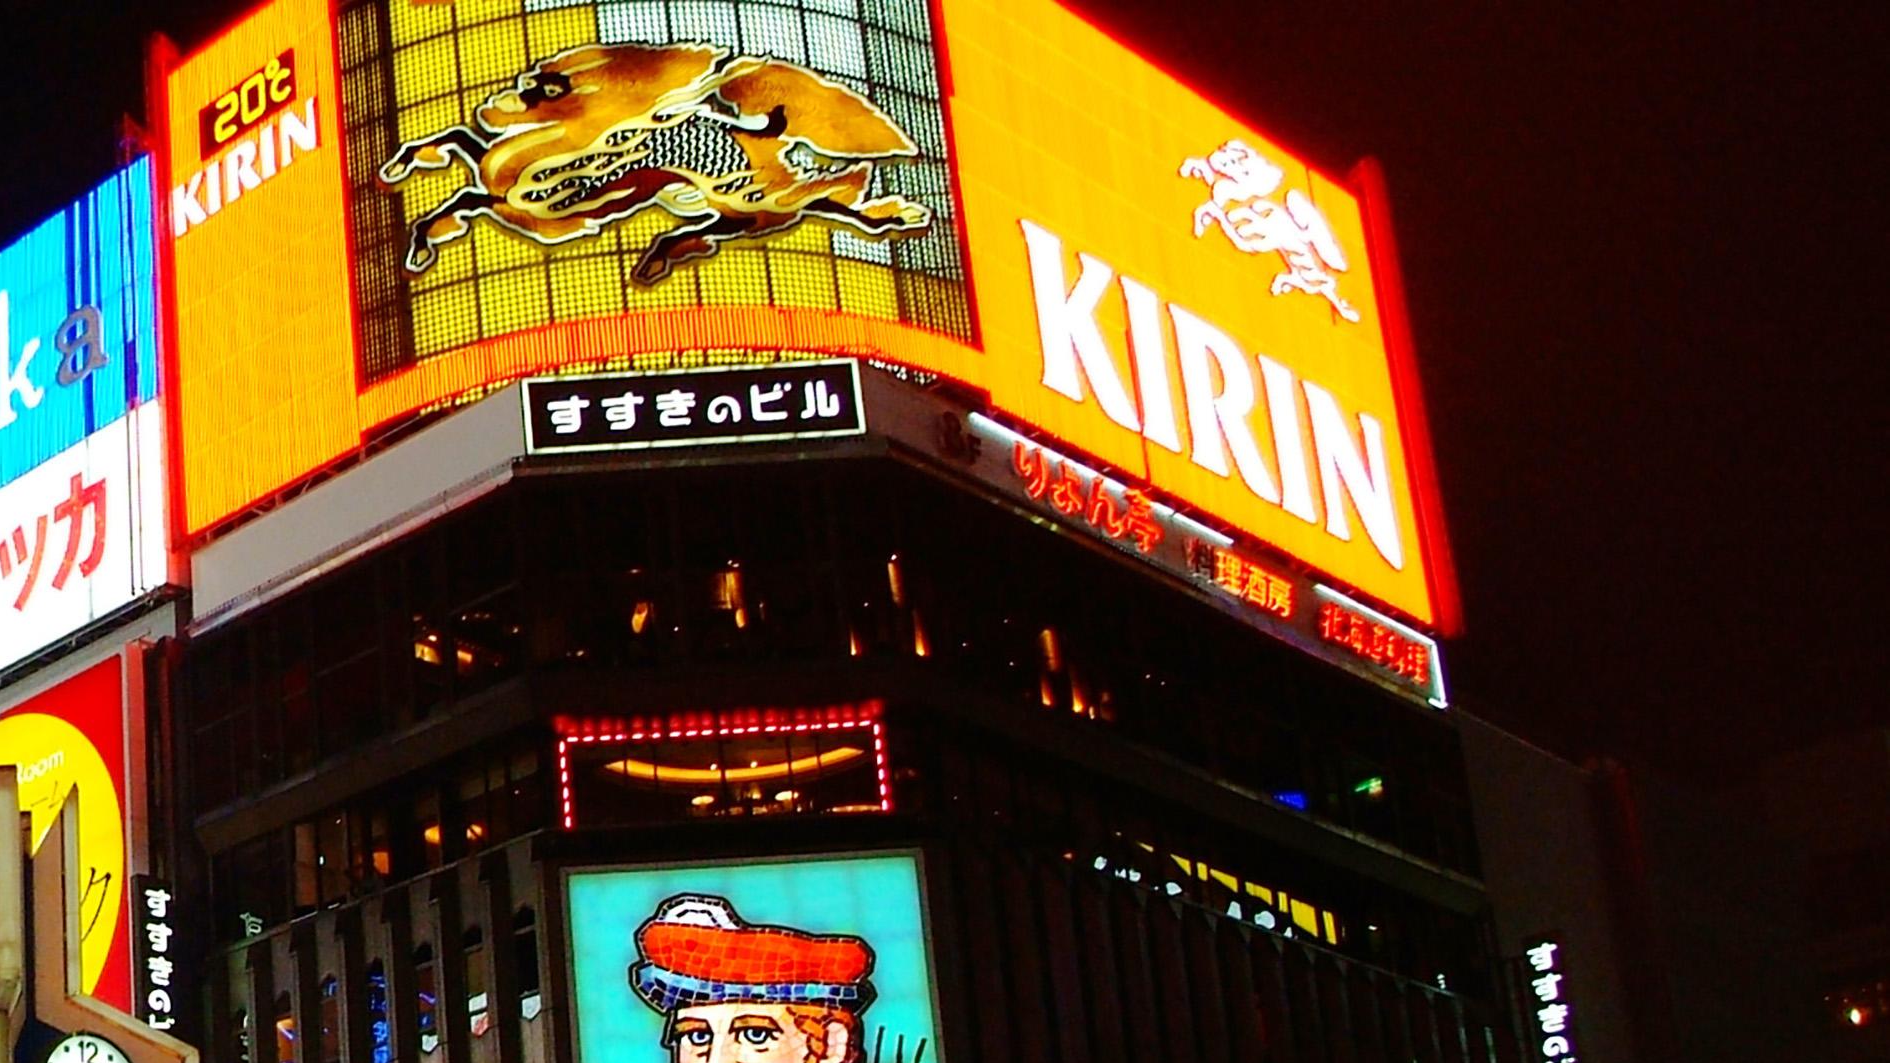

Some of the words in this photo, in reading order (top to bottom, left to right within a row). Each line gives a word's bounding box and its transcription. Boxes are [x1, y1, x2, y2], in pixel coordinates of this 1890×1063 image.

[169, 97, 319, 238] KIRIN
[547, 380, 841, 434] すすきのビル
[1020, 218, 1403, 571] KIRIN
